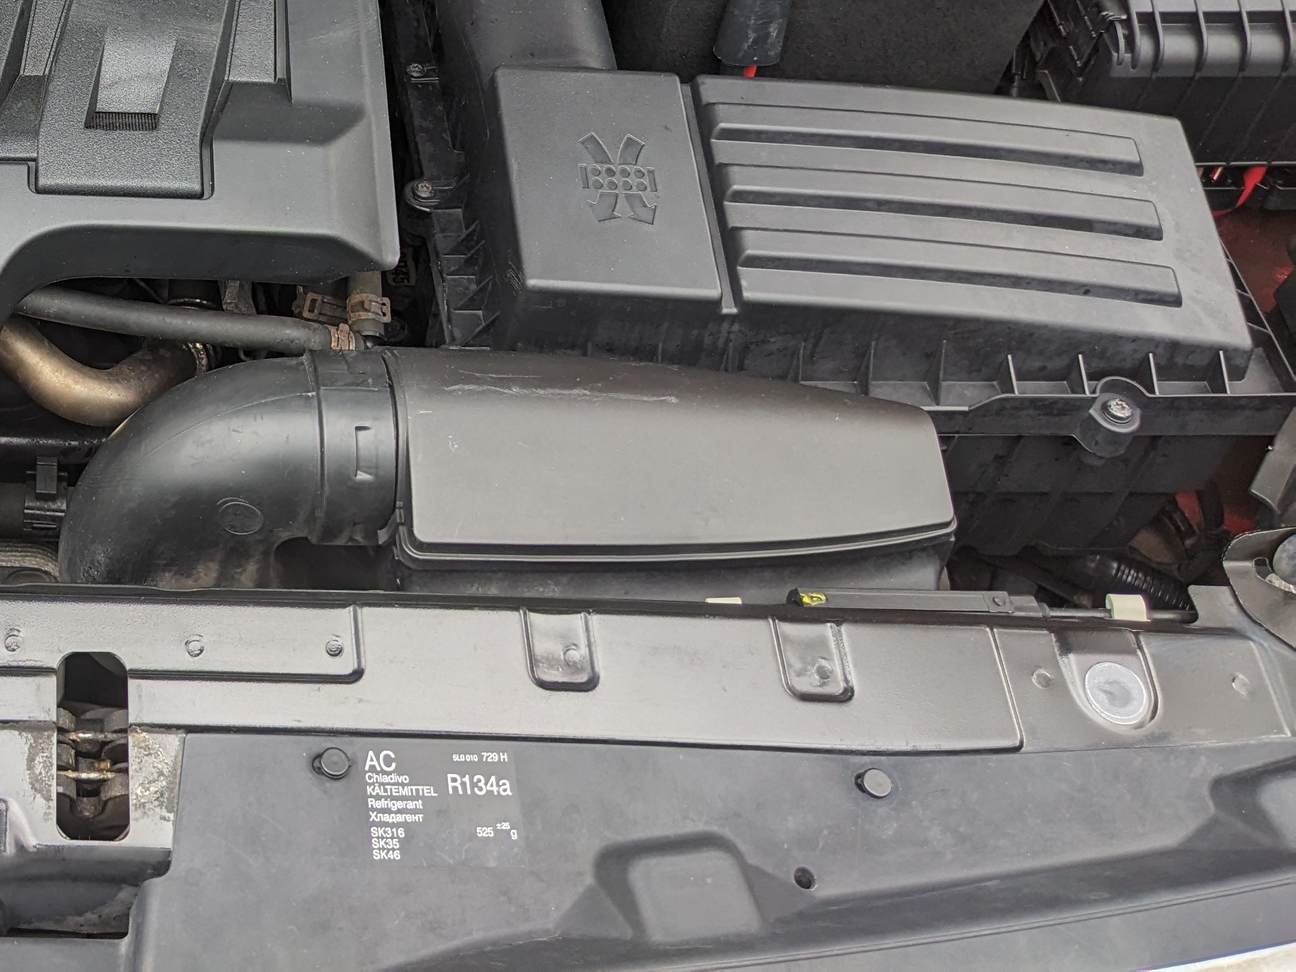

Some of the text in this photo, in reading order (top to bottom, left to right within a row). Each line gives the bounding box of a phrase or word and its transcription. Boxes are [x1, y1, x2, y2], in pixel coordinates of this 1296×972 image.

[364, 749, 396, 772] AC
[481, 752, 499, 762] 729
[500, 752, 508, 762] H
[365, 772, 409, 784] Chladivo
[447, 773, 513, 796] R134a
[366, 783, 438, 797] KÄLTEMITTEL
[367, 797, 423, 811] Refrigerant
[369, 811, 424, 824] Хладагент
[370, 827, 405, 838] SK316
[476, 826, 494, 837] 525
[510, 829, 518, 840] g
[371, 838, 400, 849] SK35
[372, 849, 401, 860] SK46
